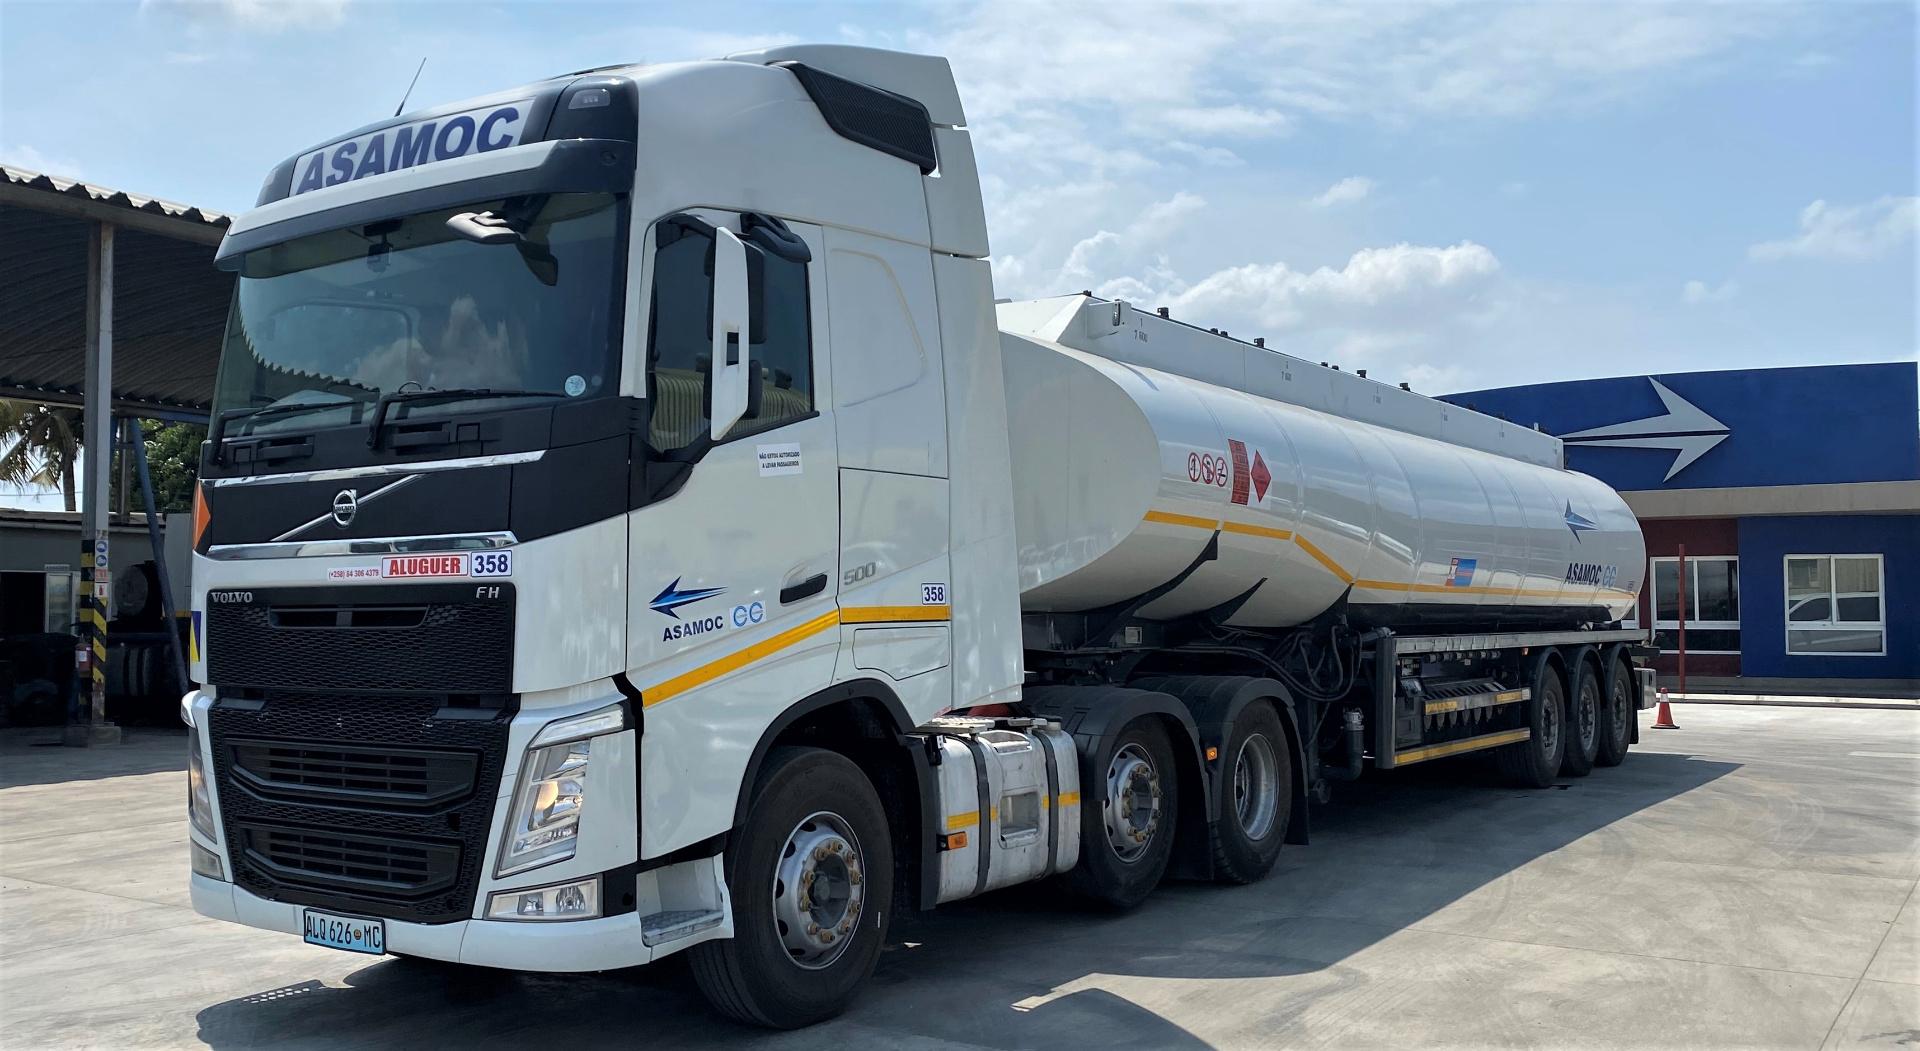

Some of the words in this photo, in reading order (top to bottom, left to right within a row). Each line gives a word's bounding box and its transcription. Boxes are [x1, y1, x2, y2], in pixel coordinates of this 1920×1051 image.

[296, 107, 519, 195] ASAMOC
[389, 557, 461, 576] ALUGUER
[474, 553, 508, 574] 358
[844, 562, 876, 586] 500
[1565, 563, 1602, 585] ASAMOC
[211, 591, 253, 603] VOLVO
[475, 586, 500, 599] FH
[923, 586, 944, 602] 358
[663, 616, 724, 642] ASAMOC
[306, 915, 326, 940] ALQ
[330, 920, 352, 945] 626
[363, 925, 381, 948] MC
